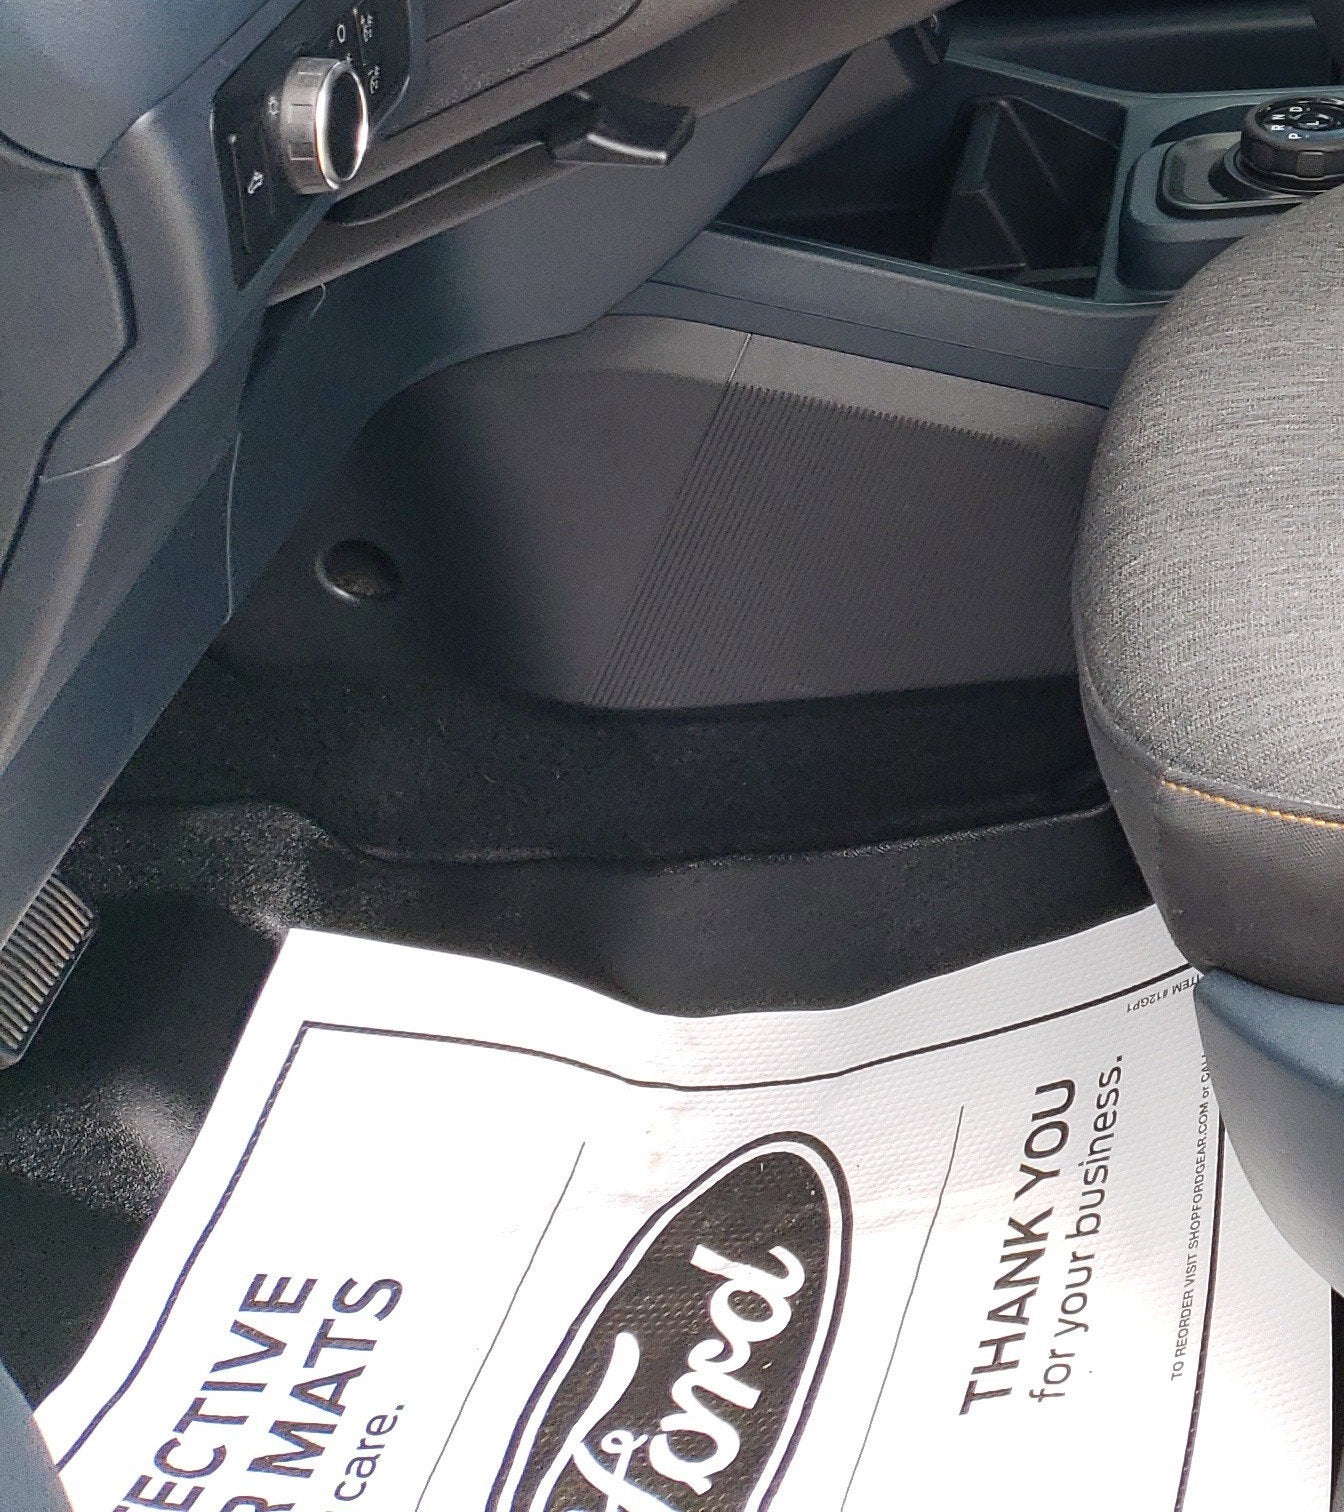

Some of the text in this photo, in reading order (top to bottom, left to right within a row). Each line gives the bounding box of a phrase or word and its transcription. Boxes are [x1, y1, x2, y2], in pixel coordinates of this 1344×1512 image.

[1126, 987, 1169, 1013] #12GP1
[1201, 1085, 1211, 1099] or
[1029, 1054, 1124, 1403] for your business.
[1188, 1101, 1211, 1250] SHOPFORDGEAR.COM
[959, 1078, 1077, 1416] THANK YOU
[1184, 1252, 1198, 1287] VISIT
[247, 1278, 404, 1479] MATS
[530, 1244, 806, 1512] Ford
[1170, 1361, 1185, 1382] TO
[1175, 1289, 1195, 1359] REORDER
[112, 1273, 319, 1512] ECTIVE
[334, 1404, 406, 1502] care.
